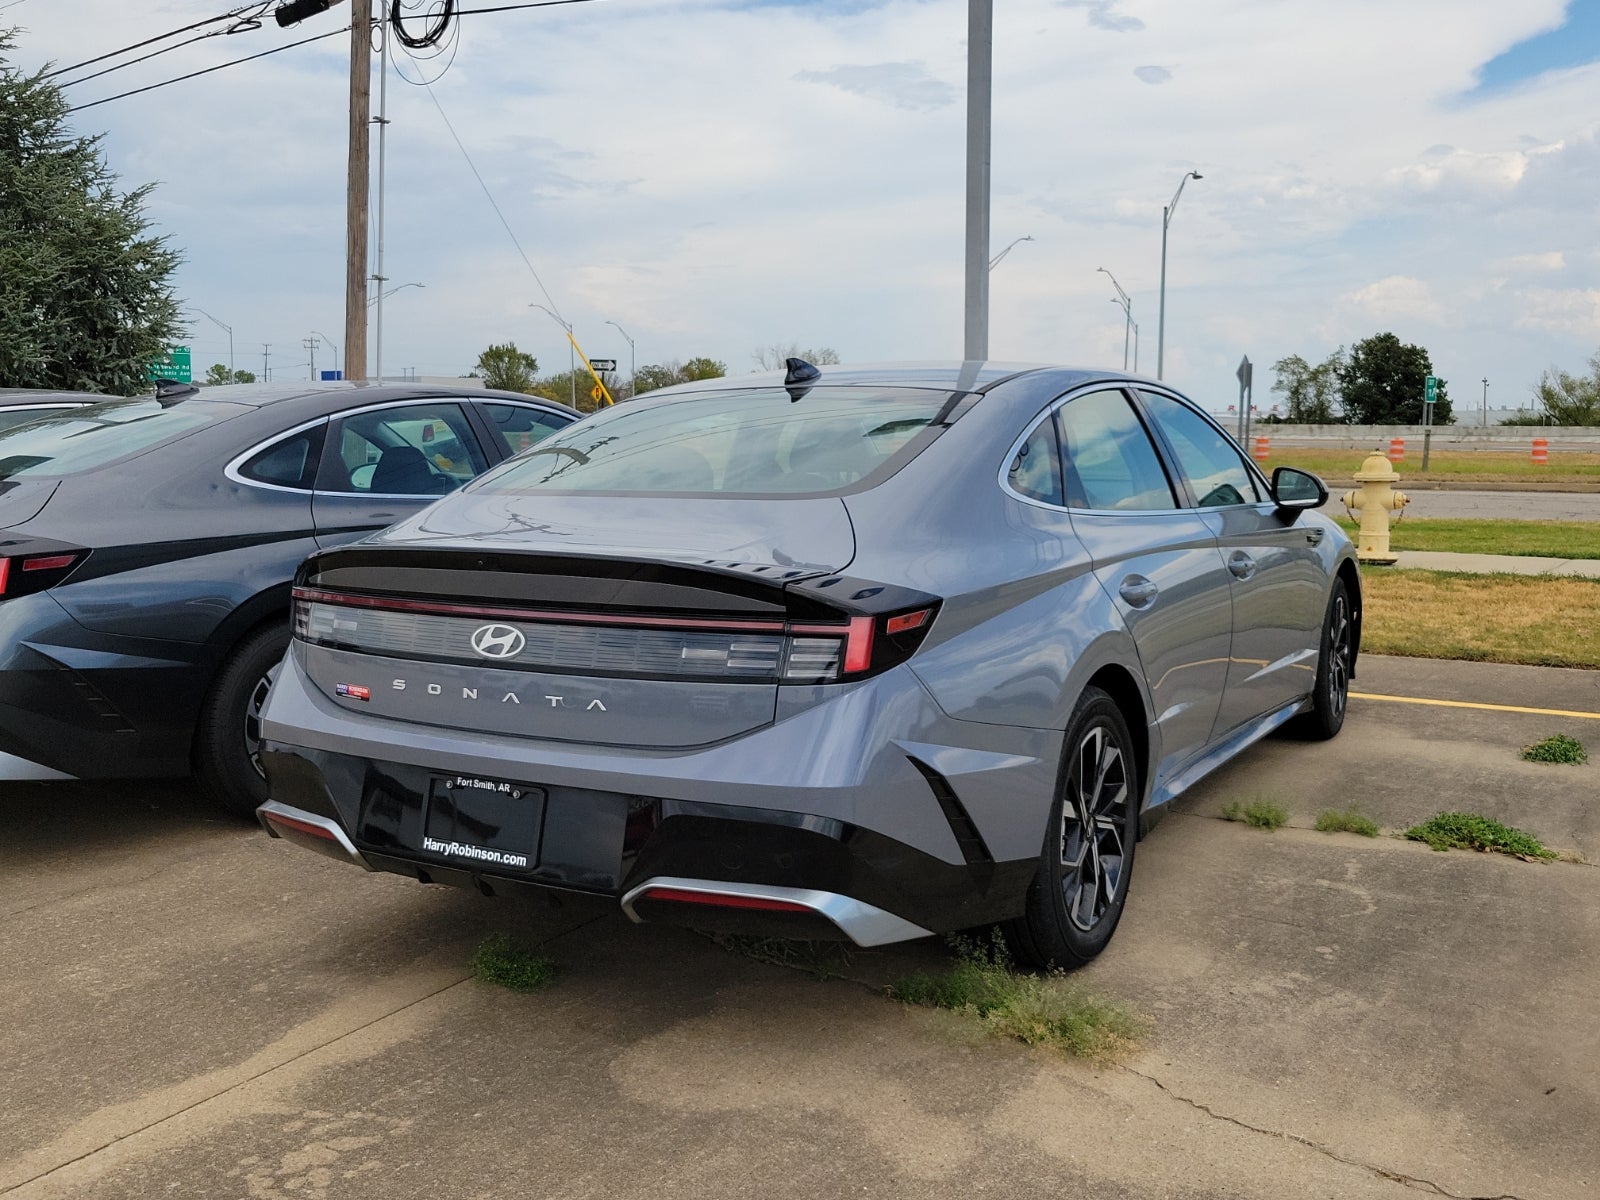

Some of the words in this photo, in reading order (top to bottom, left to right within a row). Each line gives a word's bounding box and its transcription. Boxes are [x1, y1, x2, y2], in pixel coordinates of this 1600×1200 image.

[392, 679, 607, 711] SONATA
[456, 777, 473, 787] Fort
[473, 779, 497, 792] Smith,
[497, 783, 511, 792] AR
[423, 837, 527, 867] HarryRobinson.com
